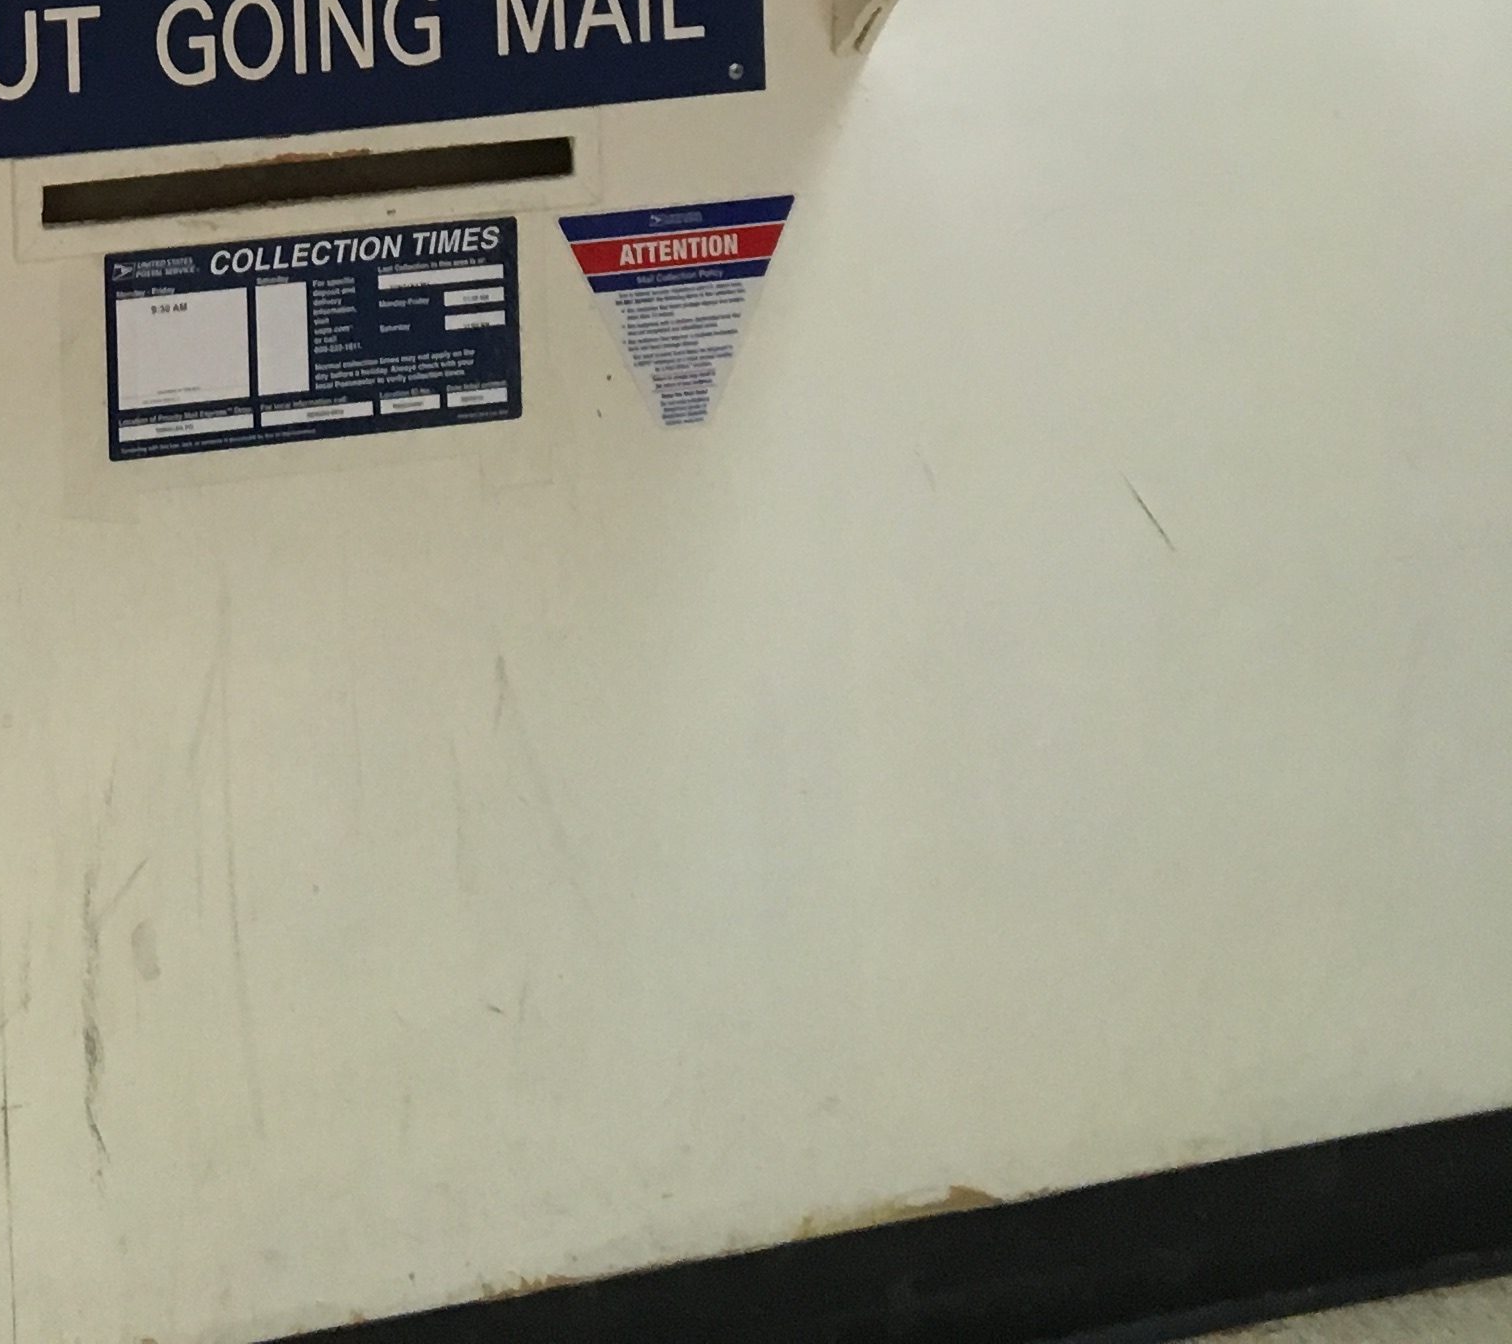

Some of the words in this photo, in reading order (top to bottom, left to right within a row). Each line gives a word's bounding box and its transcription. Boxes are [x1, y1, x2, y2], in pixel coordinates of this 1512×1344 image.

[209, 234, 402, 276] COLLECTION
[412, 225, 501, 257] TIMES
[618, 233, 739, 266] ATTENTION
